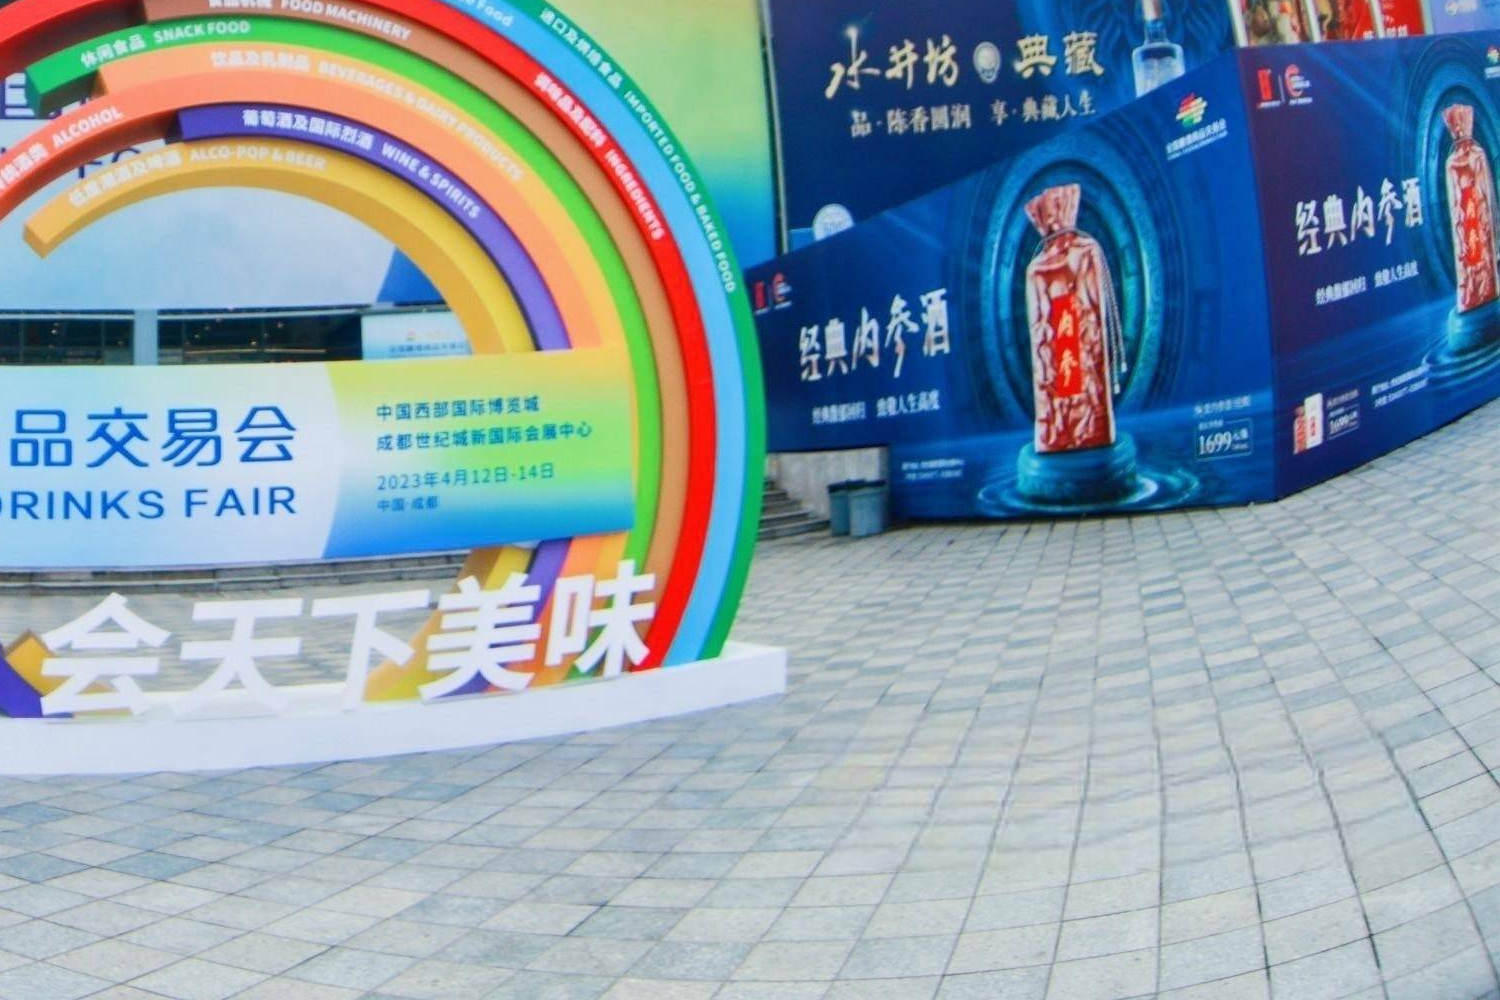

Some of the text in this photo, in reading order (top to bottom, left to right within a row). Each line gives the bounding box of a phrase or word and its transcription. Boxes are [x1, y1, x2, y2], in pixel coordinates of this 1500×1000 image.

[81, 20, 252, 69] 休闲食品 SNACK FOOD
[326, 3, 413, 41] MACHINERY
[476, 0, 514, 28] Food
[825, 26, 1104, 100] 水井坊 典藏
[51, 106, 124, 149] ALCOHOL
[318, 60, 405, 100] BEVERAGES
[455, 122, 525, 183] PRODUCTS
[189, 145, 270, 164] ALCO-POP
[285, 149, 327, 171] BEER
[381, 142, 420, 174] WINE
[418, 164, 431, 181] &
[429, 172, 482, 219] SPIRITS
[604, 148, 666, 241] INGREDIENTS
[623, 90, 674, 156] IMPORTED
[668, 154, 696, 194] FOOD
[690, 192, 702, 205] &
[696, 204, 723, 251] BAKED
[715, 249, 736, 293] FOOD
[1294, 176, 1424, 256] 经典内参酒
[799, 288, 951, 382] 经典内参酒
[376, 395, 541, 421] 中国西部国际博览城
[376, 421, 593, 452] 成都世纪城新国际会展中心
[185, 485, 297, 518] FAIR
[40, 557, 657, 718] 会天下美味
